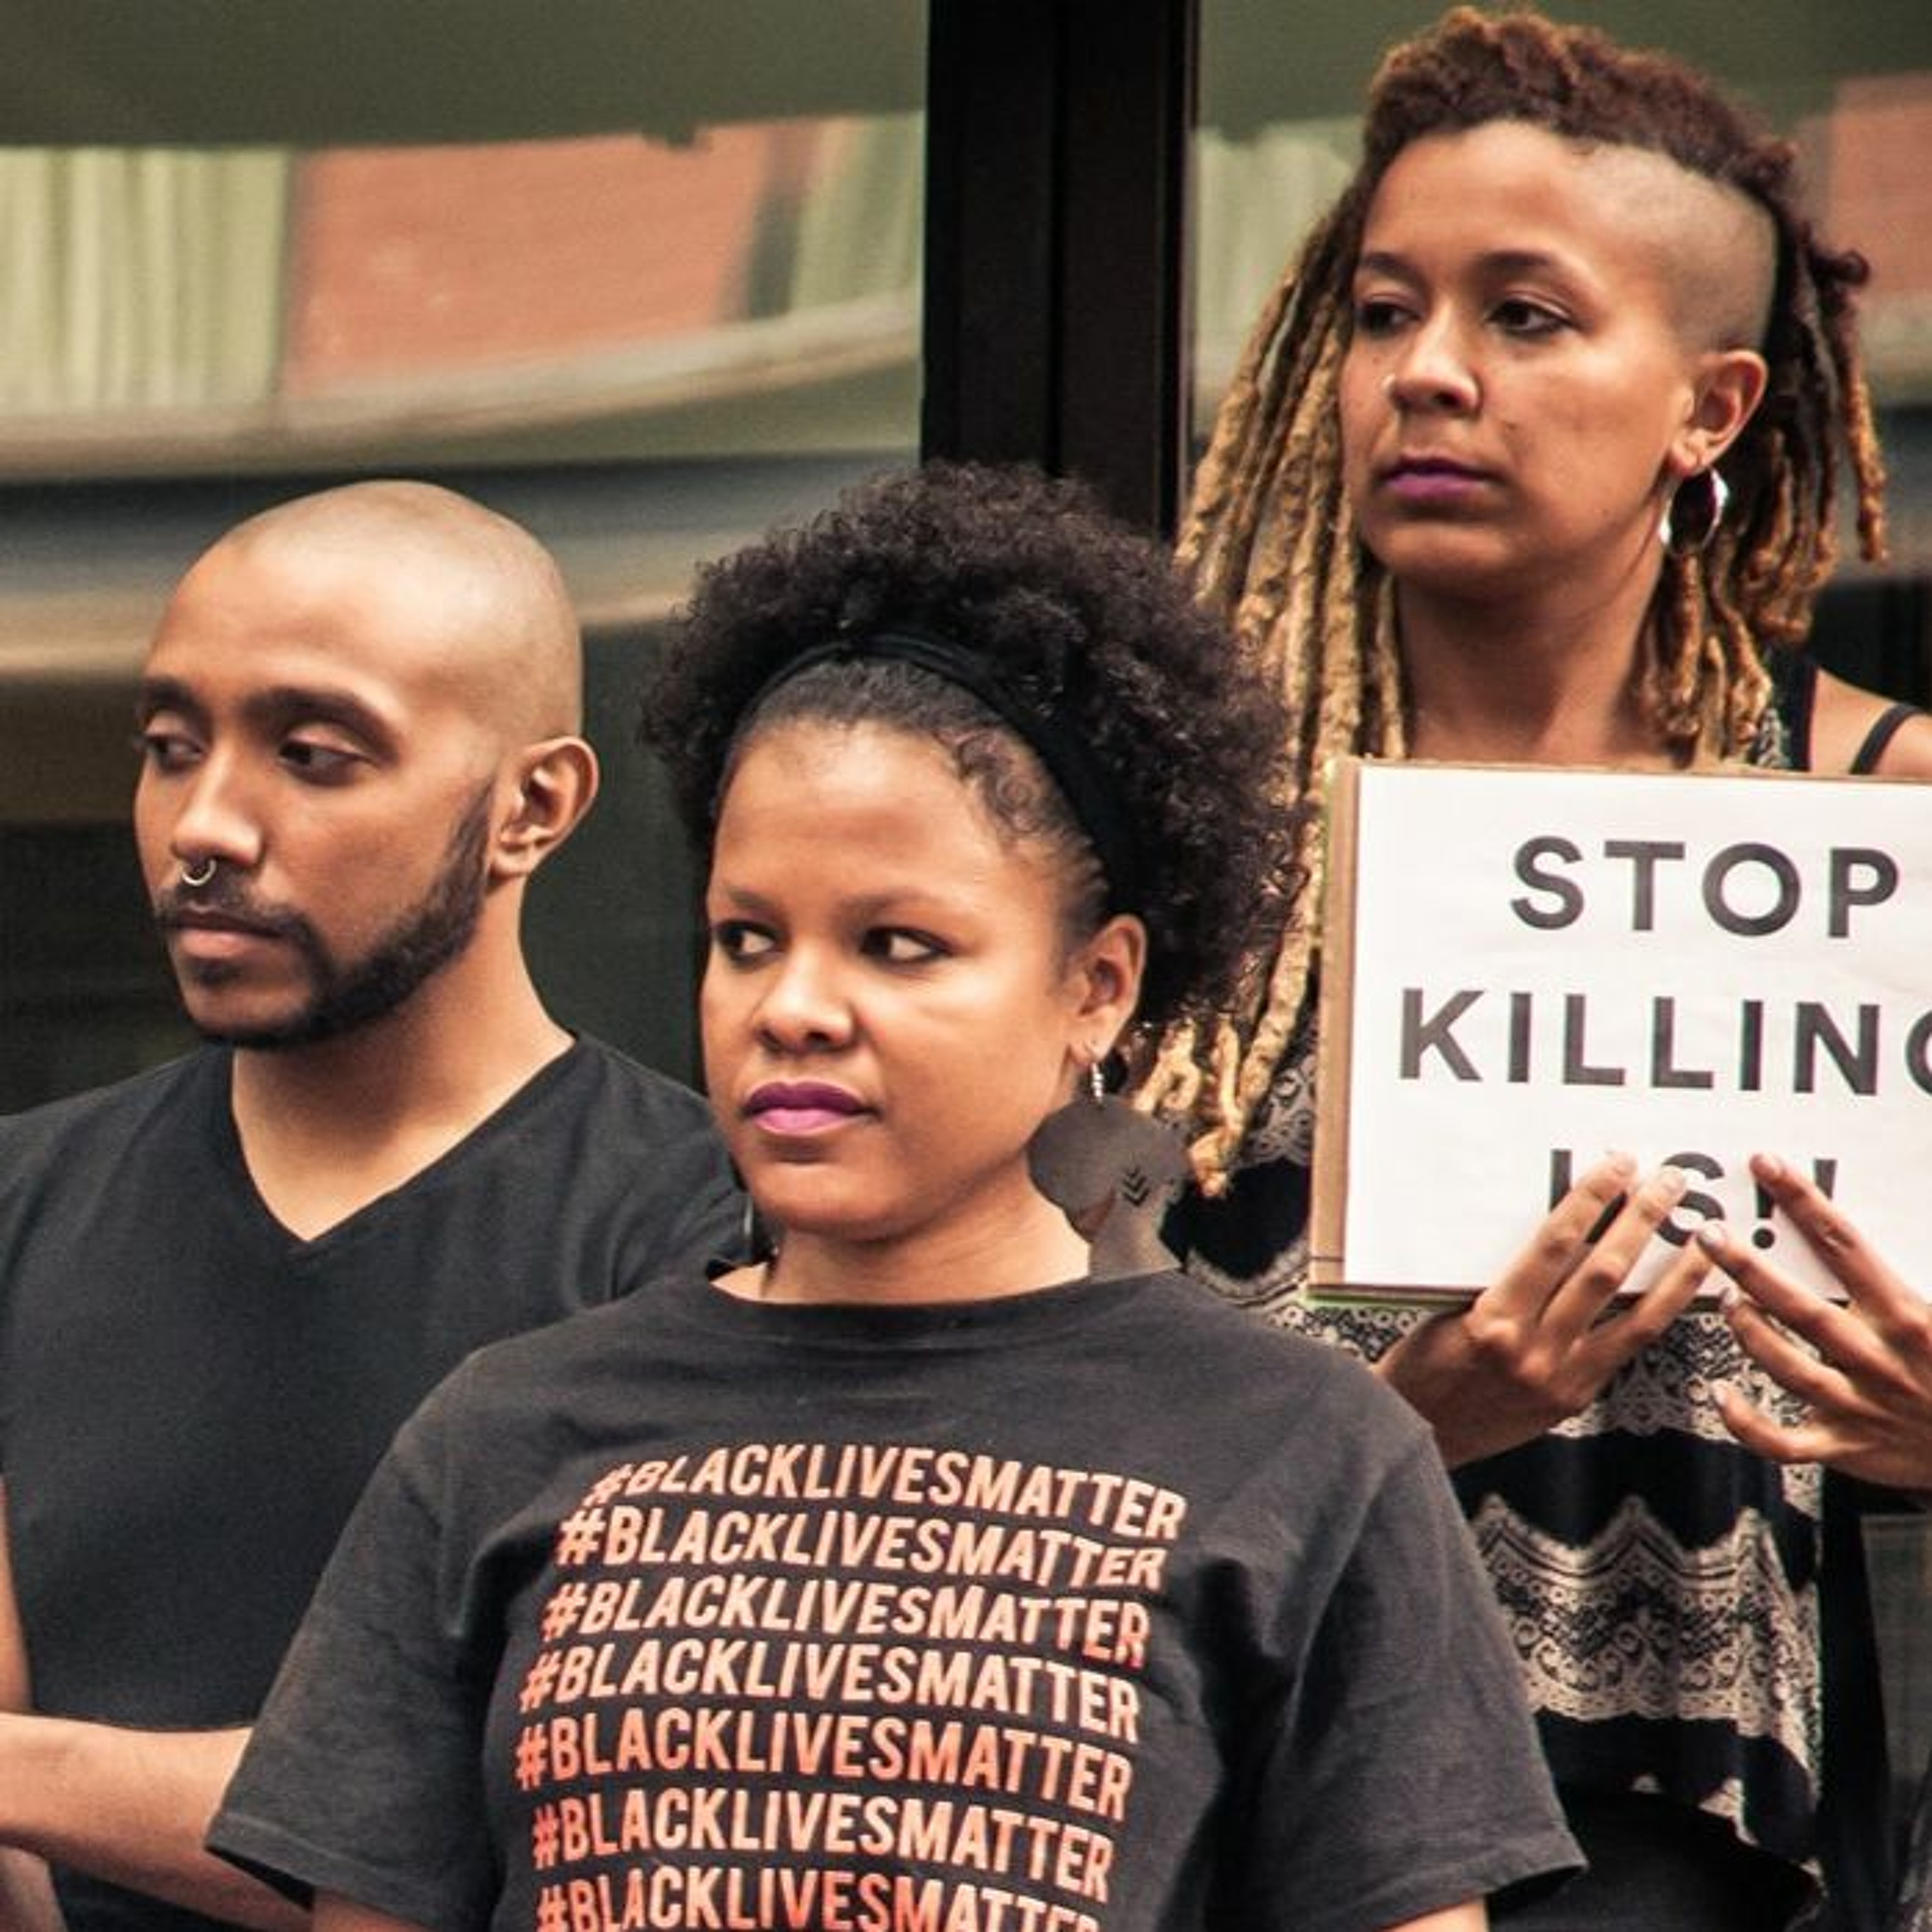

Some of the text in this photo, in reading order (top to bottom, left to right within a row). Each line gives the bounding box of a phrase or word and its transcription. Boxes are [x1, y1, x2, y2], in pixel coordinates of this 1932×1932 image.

[1510, 836, 1899, 938] STOP
[582, 1443, 1189, 1541] #BLACKLIVESMATTER
[556, 1505, 1169, 1591] #BLACKLIVESMATTER
[542, 1573, 1151, 1669] #BLACKLIVESMATTER
[519, 1638, 1142, 1745] #BLACKLIVESMATTER
[515, 1707, 1134, 1823] #BLACKLIVESMATTER
[533, 1787, 1115, 1905] #BLACKLIVESMATTER
[536, 1864, 1101, 1932] #BLACKLIVESMATT
